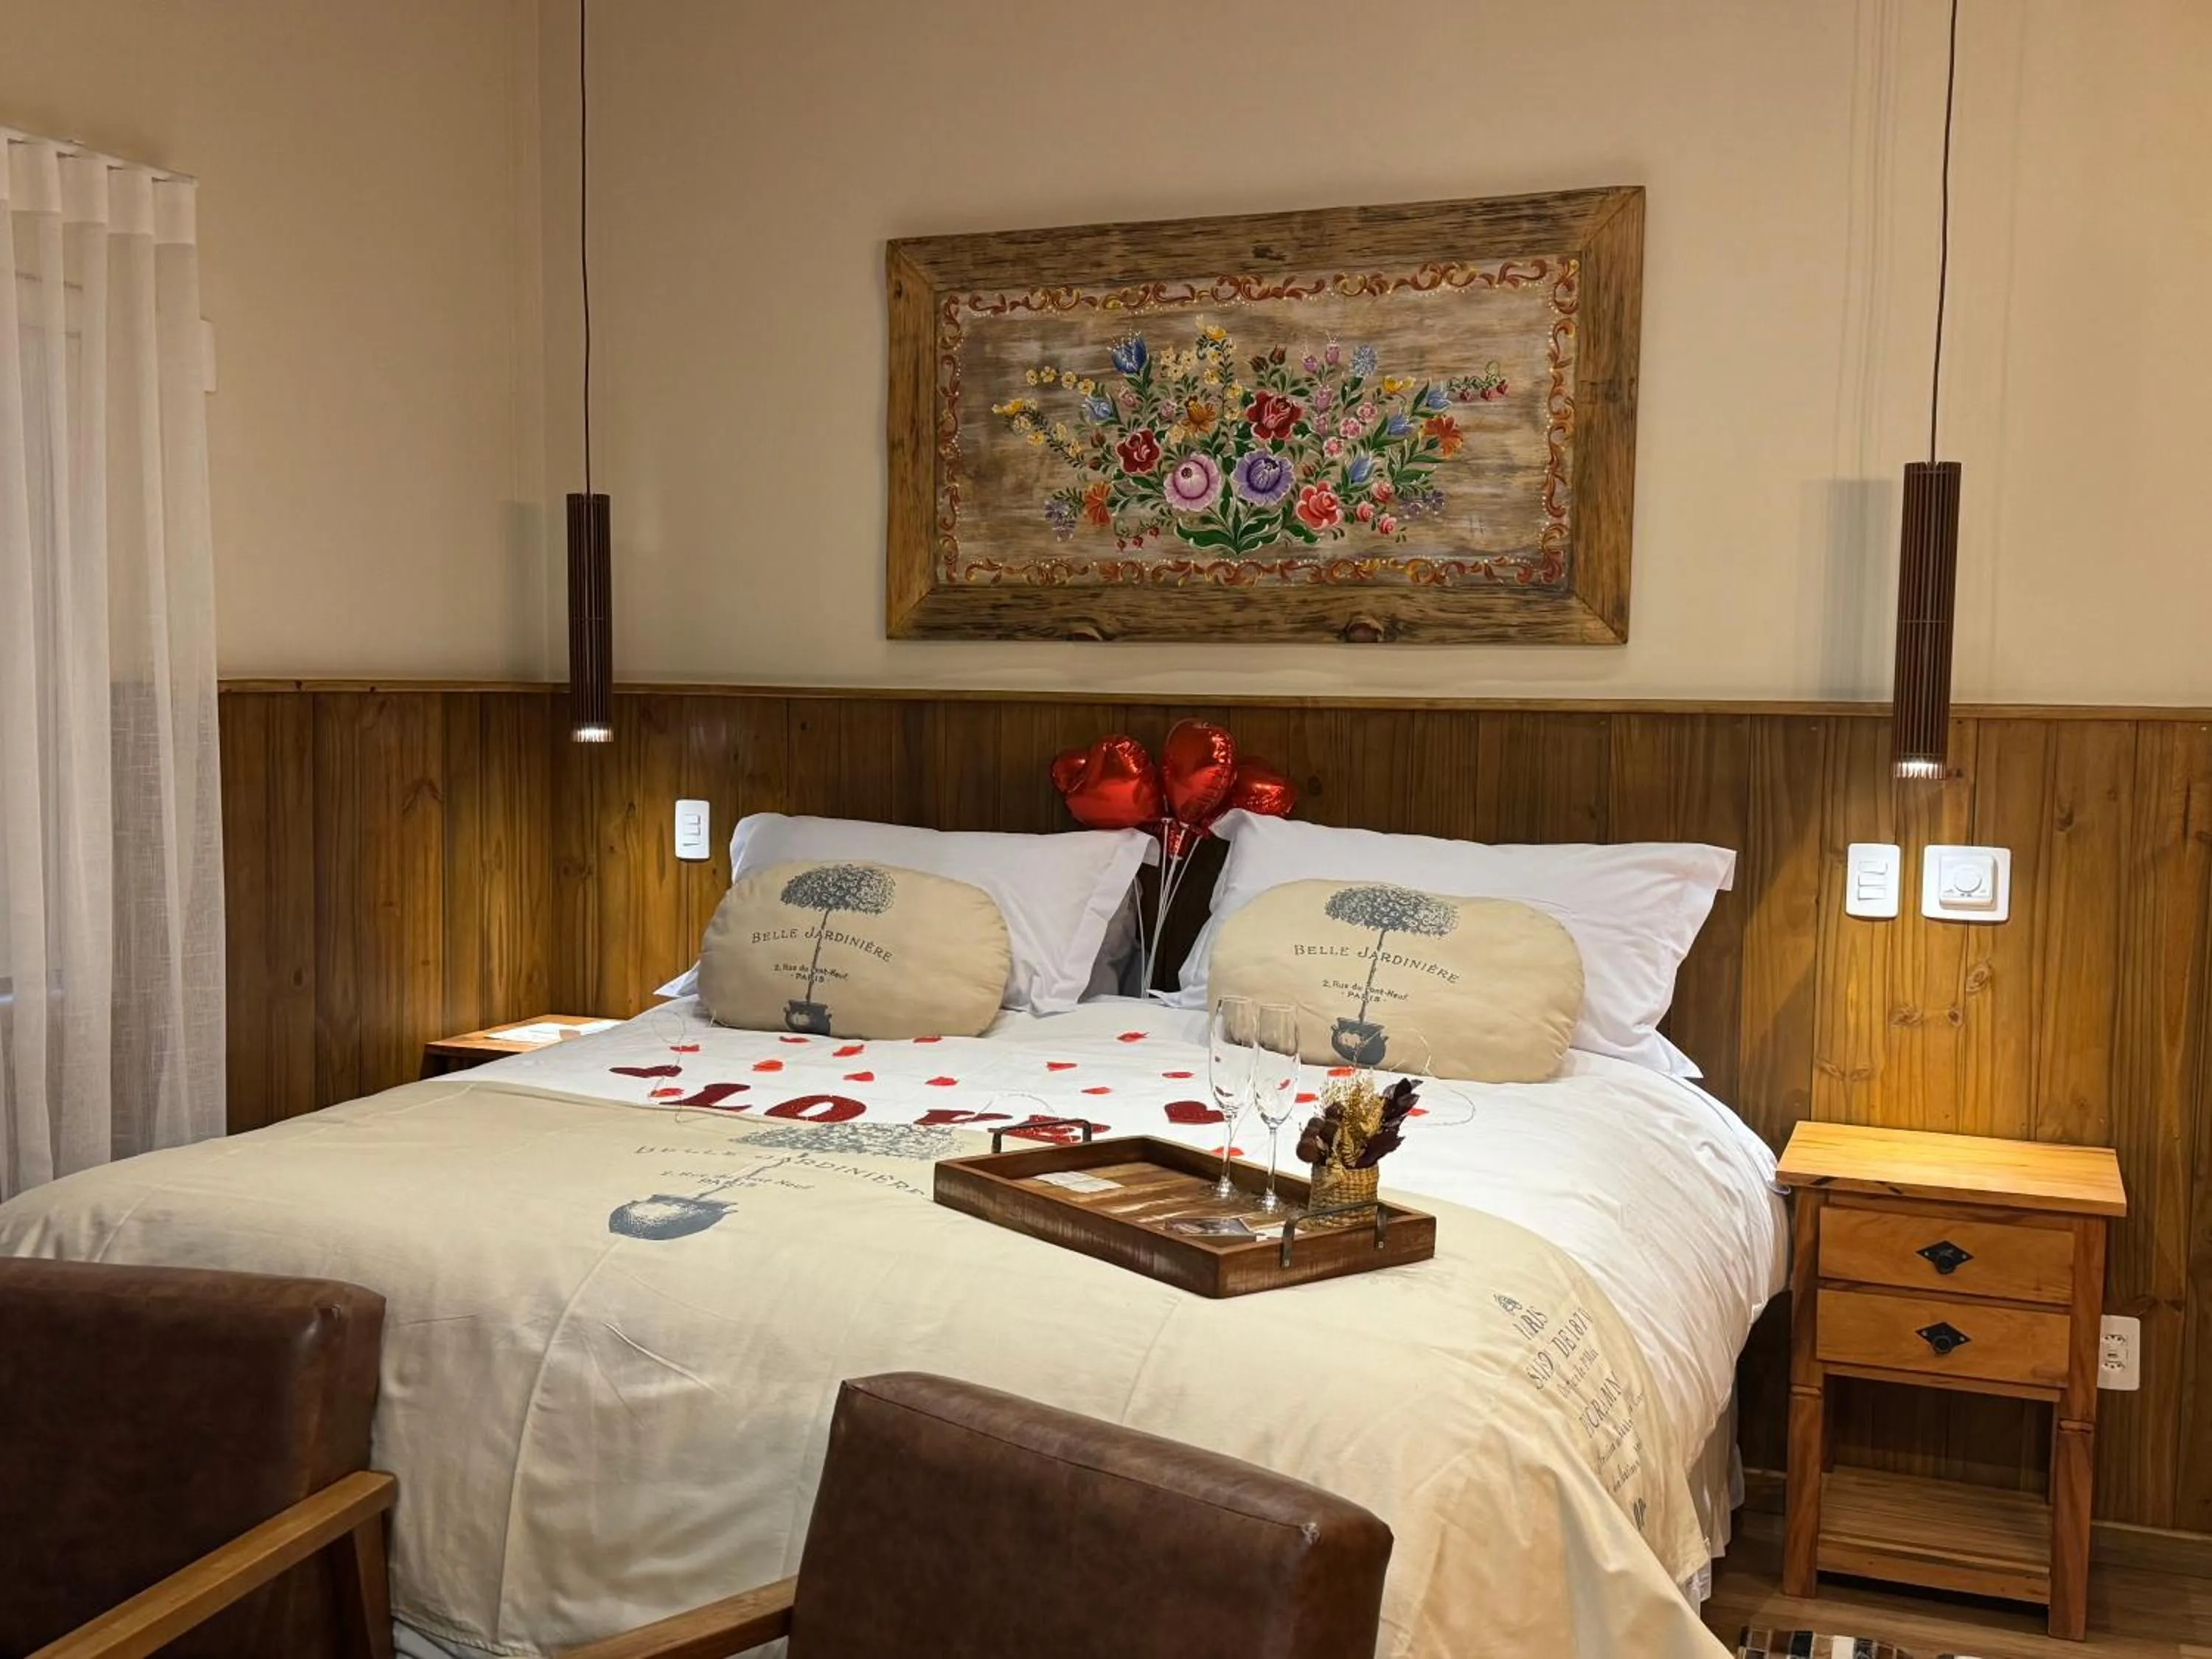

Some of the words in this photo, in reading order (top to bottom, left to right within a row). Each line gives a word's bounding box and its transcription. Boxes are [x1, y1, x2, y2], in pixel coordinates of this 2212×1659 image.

[752, 928, 799, 945] BELLE
[1294, 945, 1350, 956] BELLE
[1332, 980, 1349, 989] Rue
[1352, 982, 1363, 991] du
[1347, 990, 1381, 1003] PARIS
